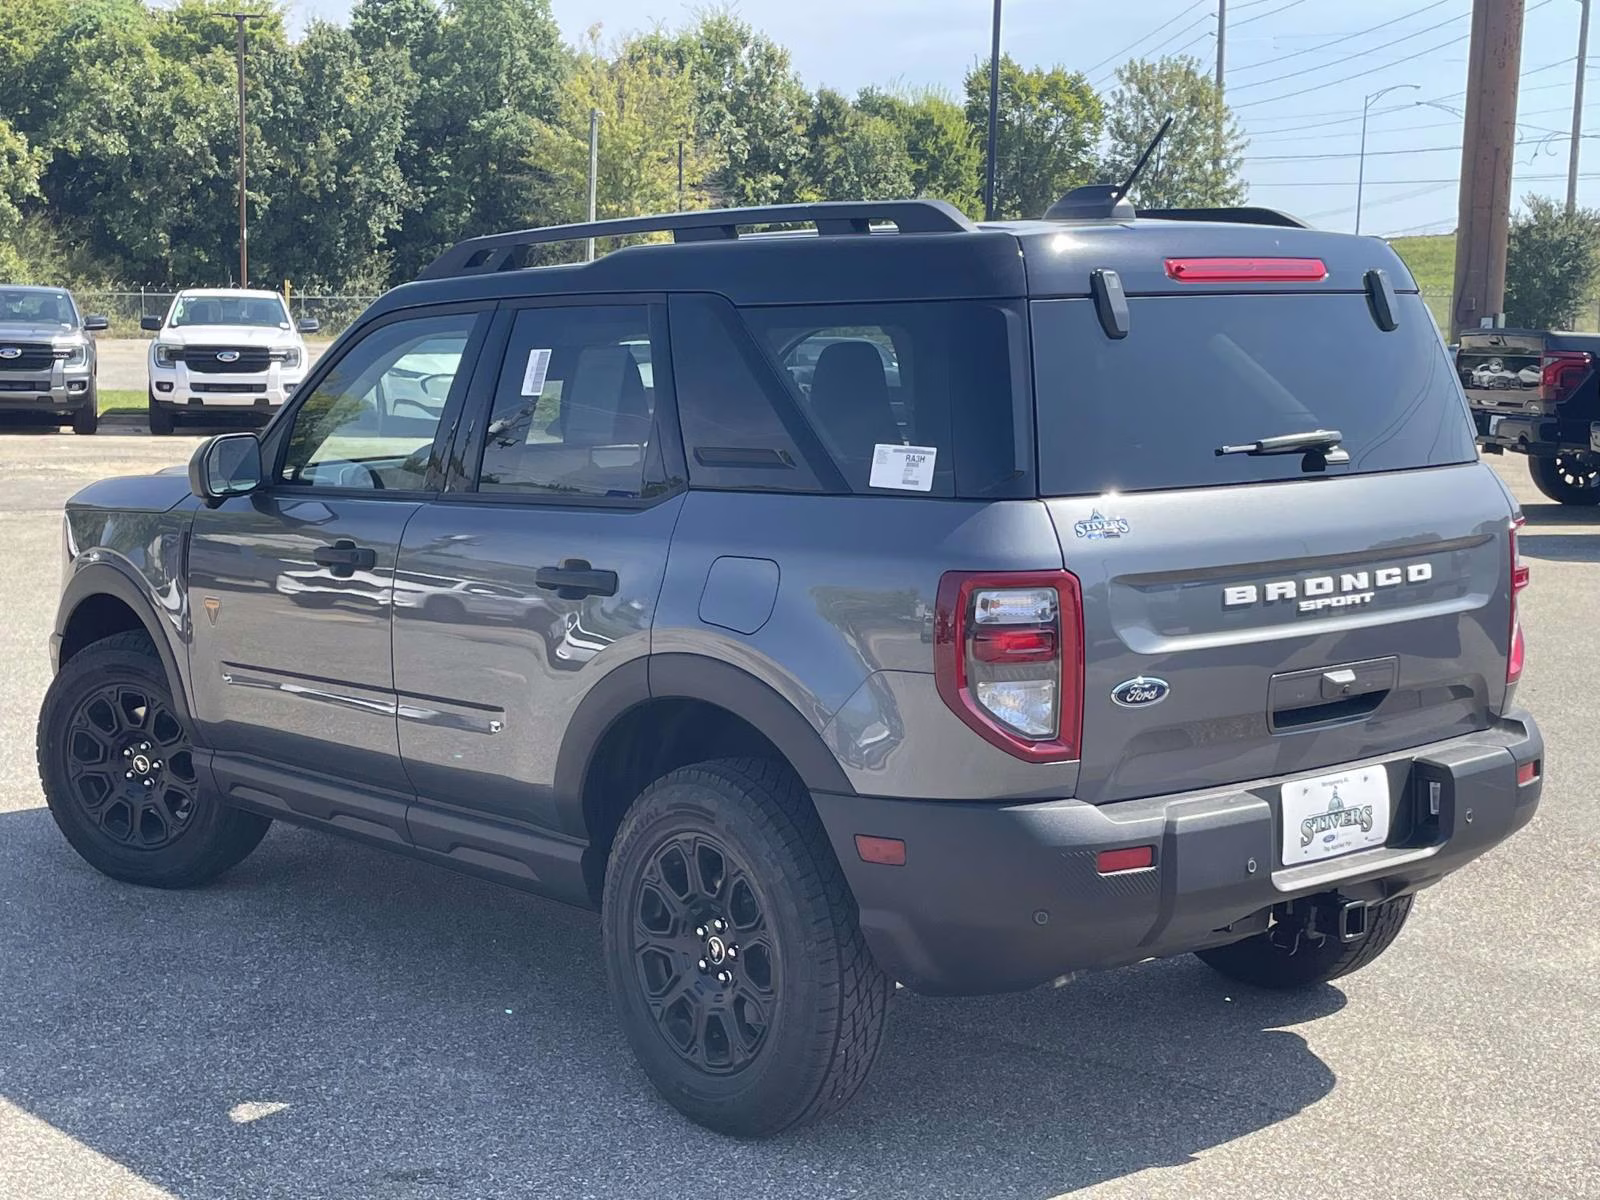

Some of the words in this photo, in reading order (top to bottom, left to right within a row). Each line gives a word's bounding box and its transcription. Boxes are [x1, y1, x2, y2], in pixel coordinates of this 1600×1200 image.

[1074, 518, 1130, 538] STIVERS
[1224, 563, 1432, 606] BRONCO
[1299, 592, 1375, 612] SPORT
[1126, 683, 1158, 702] Ford
[1300, 805, 1373, 848] STIVERS
